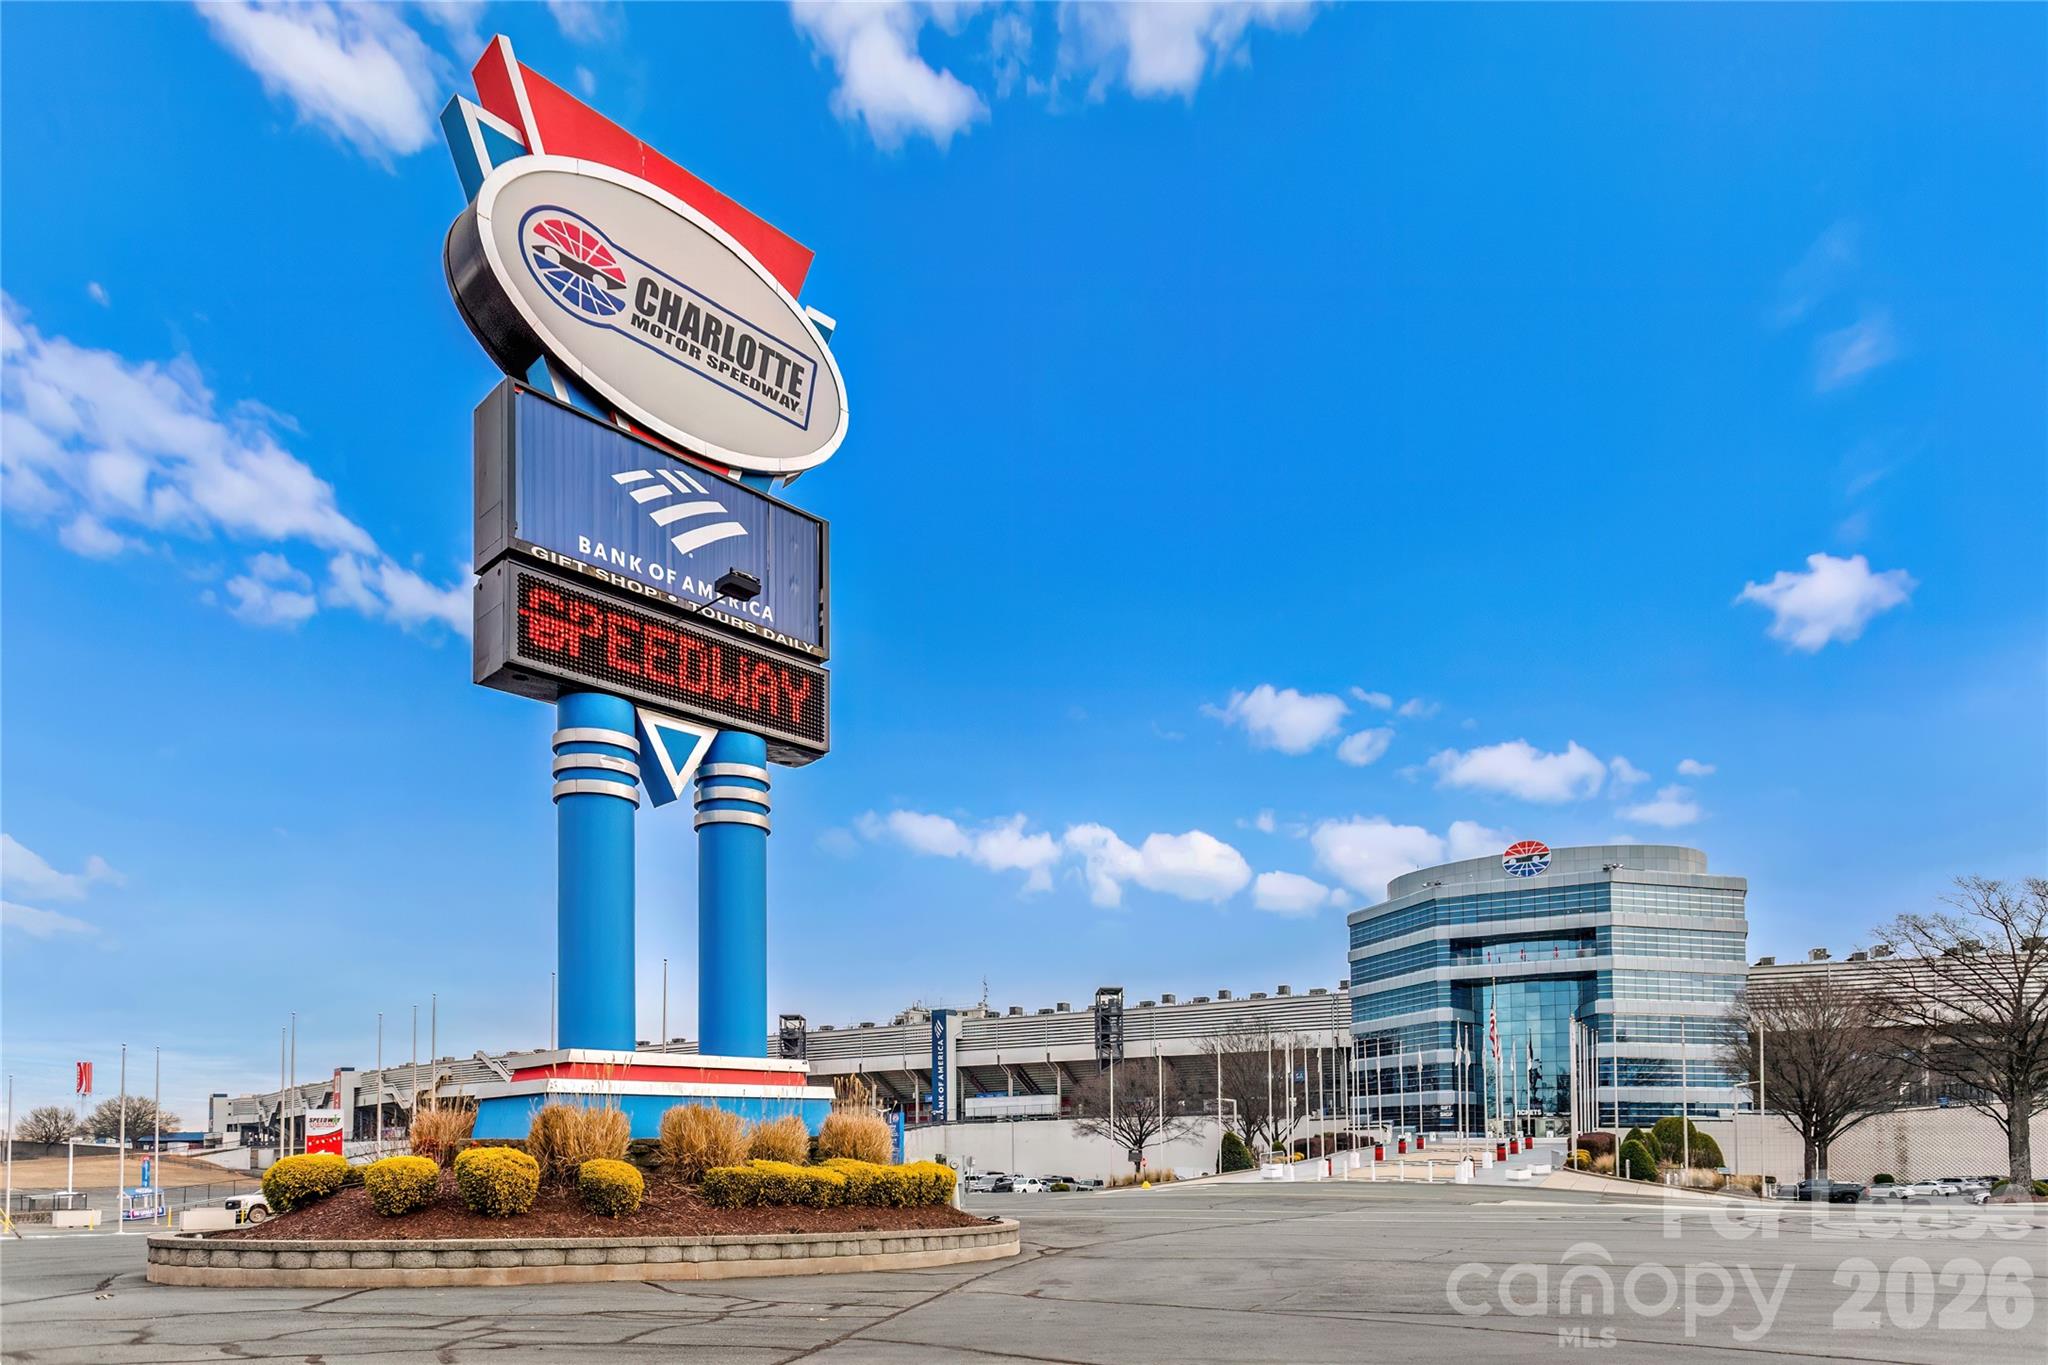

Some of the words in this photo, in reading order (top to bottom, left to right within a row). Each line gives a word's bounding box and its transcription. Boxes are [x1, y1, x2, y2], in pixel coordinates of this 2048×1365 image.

[631, 313, 702, 361] MOTOR
[706, 354, 800, 412] SPEEDWAY
[635, 277, 805, 399] CHARLOTTE
[579, 535, 643, 574] BANK
[648, 563, 677, 584] OF
[531, 546, 588, 573] GIFT
[595, 568, 658, 597] SHOP
[688, 600, 755, 634] TOURS
[762, 628, 815, 653] DAILY
[937, 1039, 945, 1081] AMERICA
[937, 1082, 945, 1094] OF
